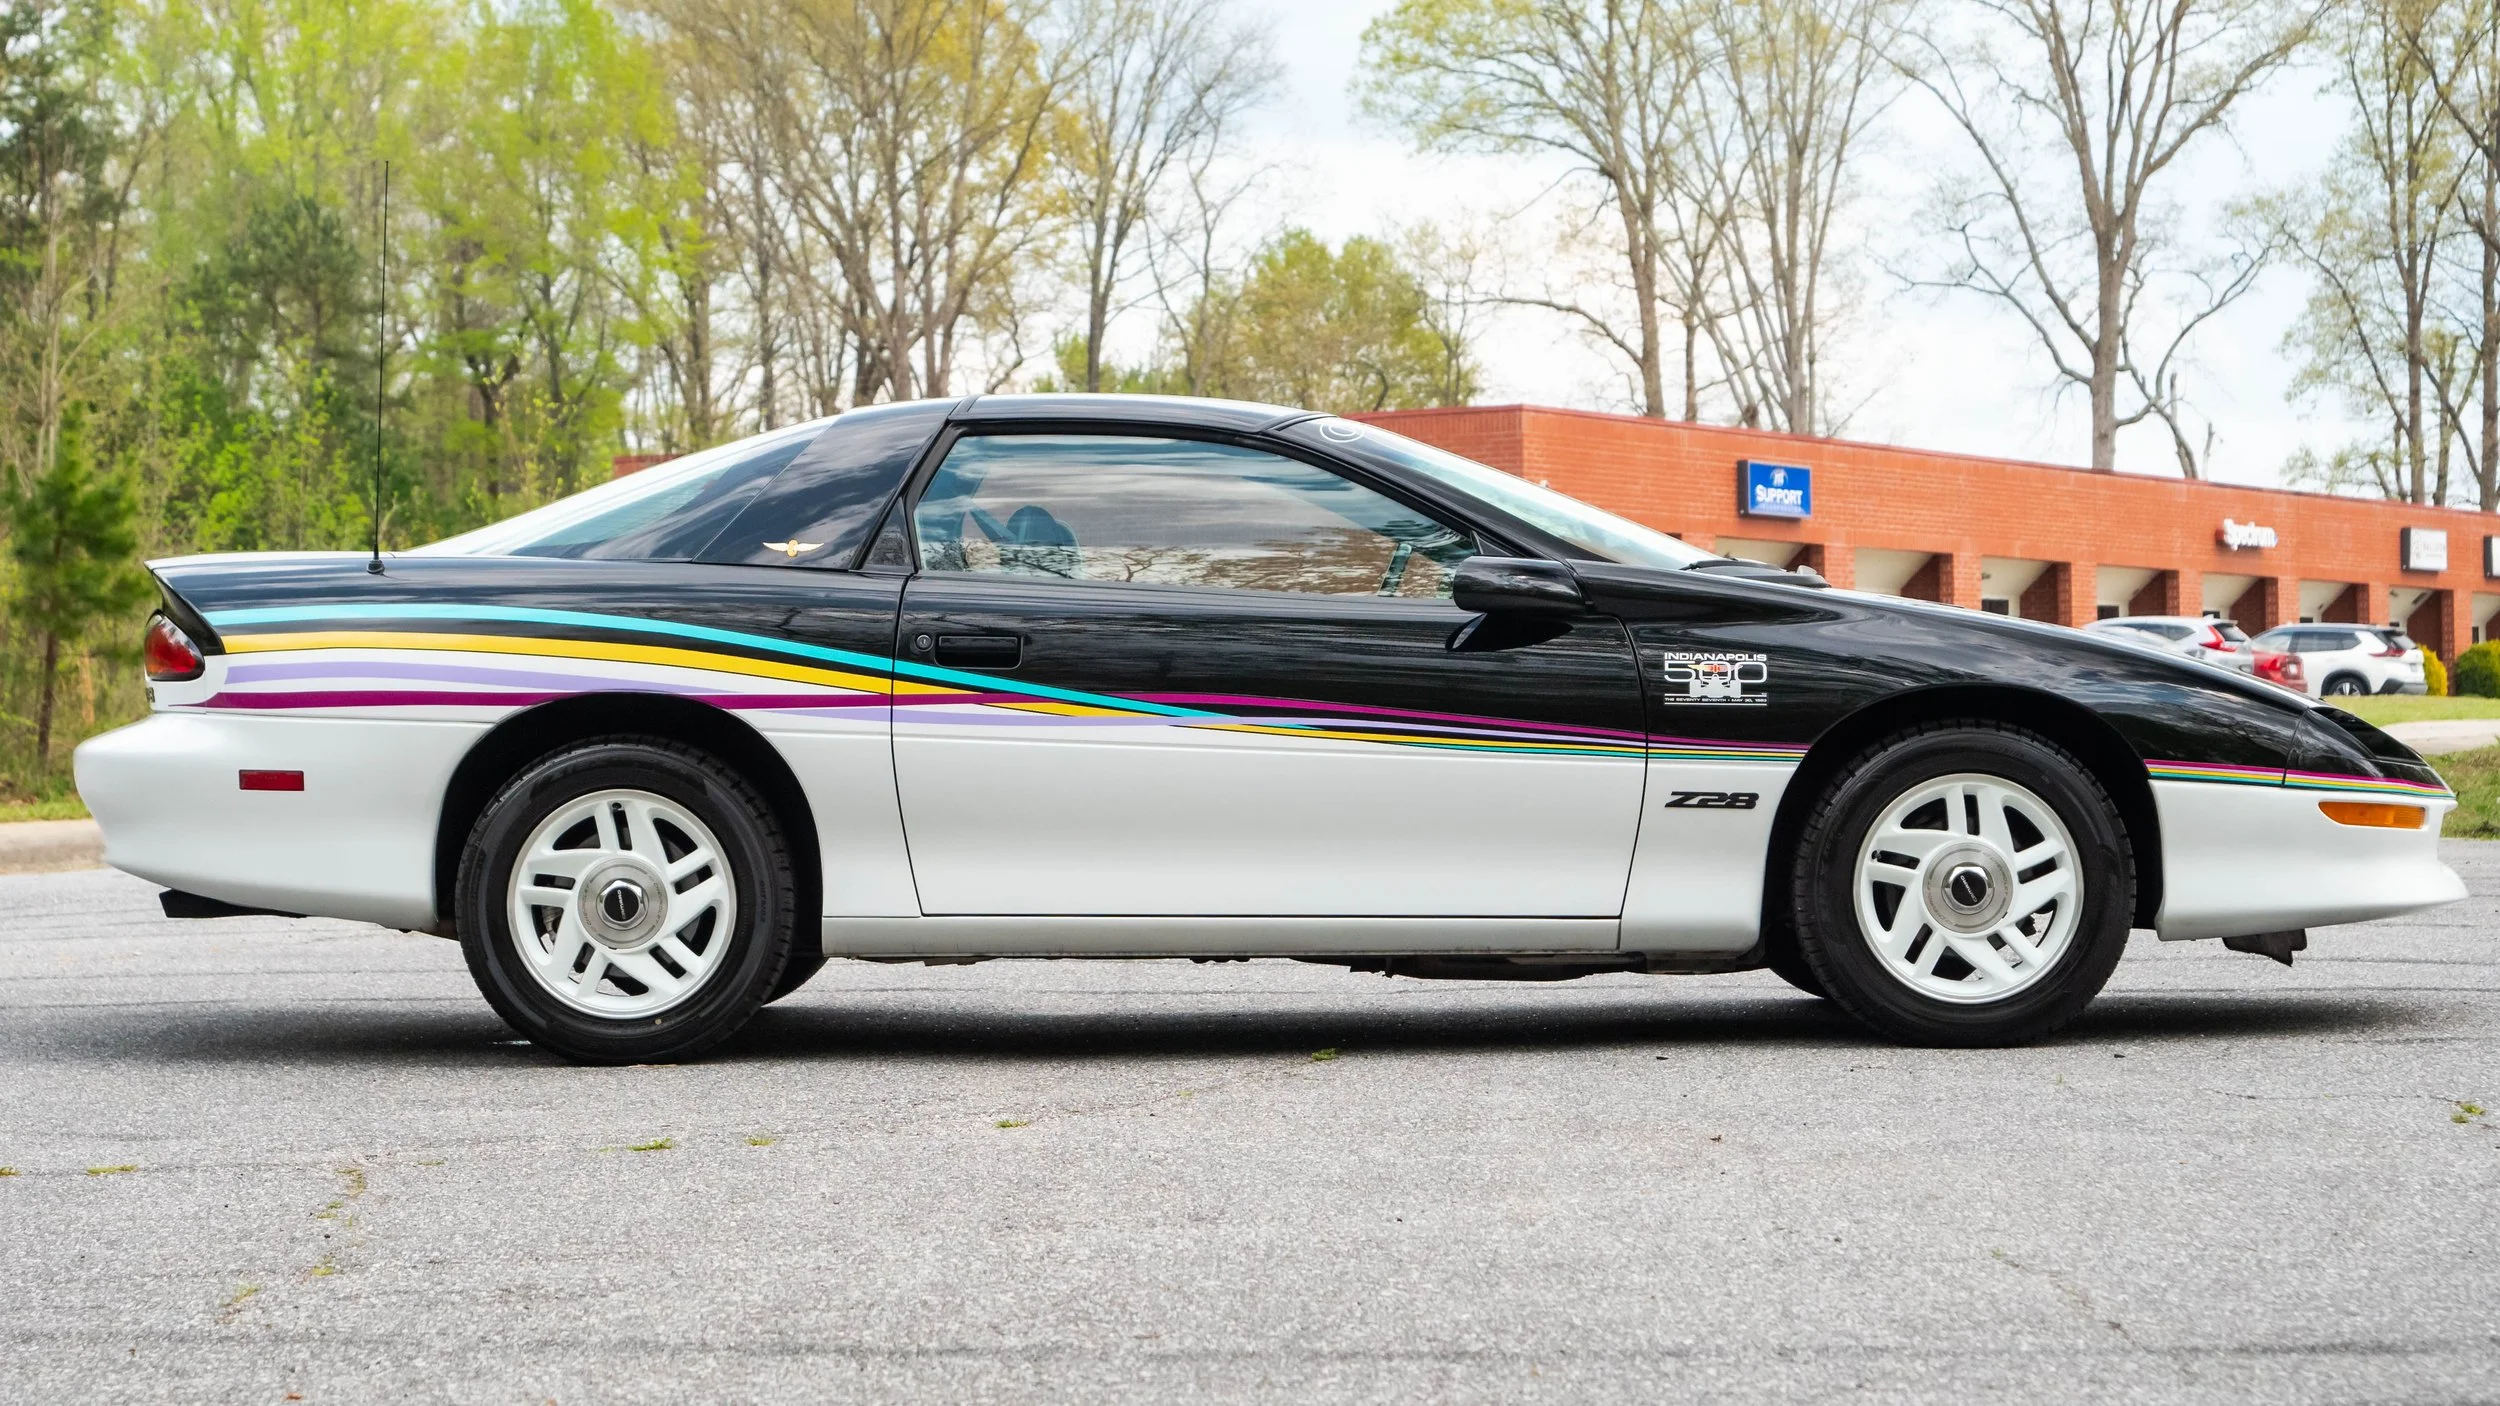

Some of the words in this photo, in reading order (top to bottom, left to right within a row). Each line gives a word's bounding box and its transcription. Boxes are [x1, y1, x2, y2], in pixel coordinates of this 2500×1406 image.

[1755, 484, 1803, 505] SUPPORT
[1664, 652, 1767, 661] INDIANAPOLIS
[1664, 660, 1768, 683] 500
[1664, 791, 1760, 809] Z28
